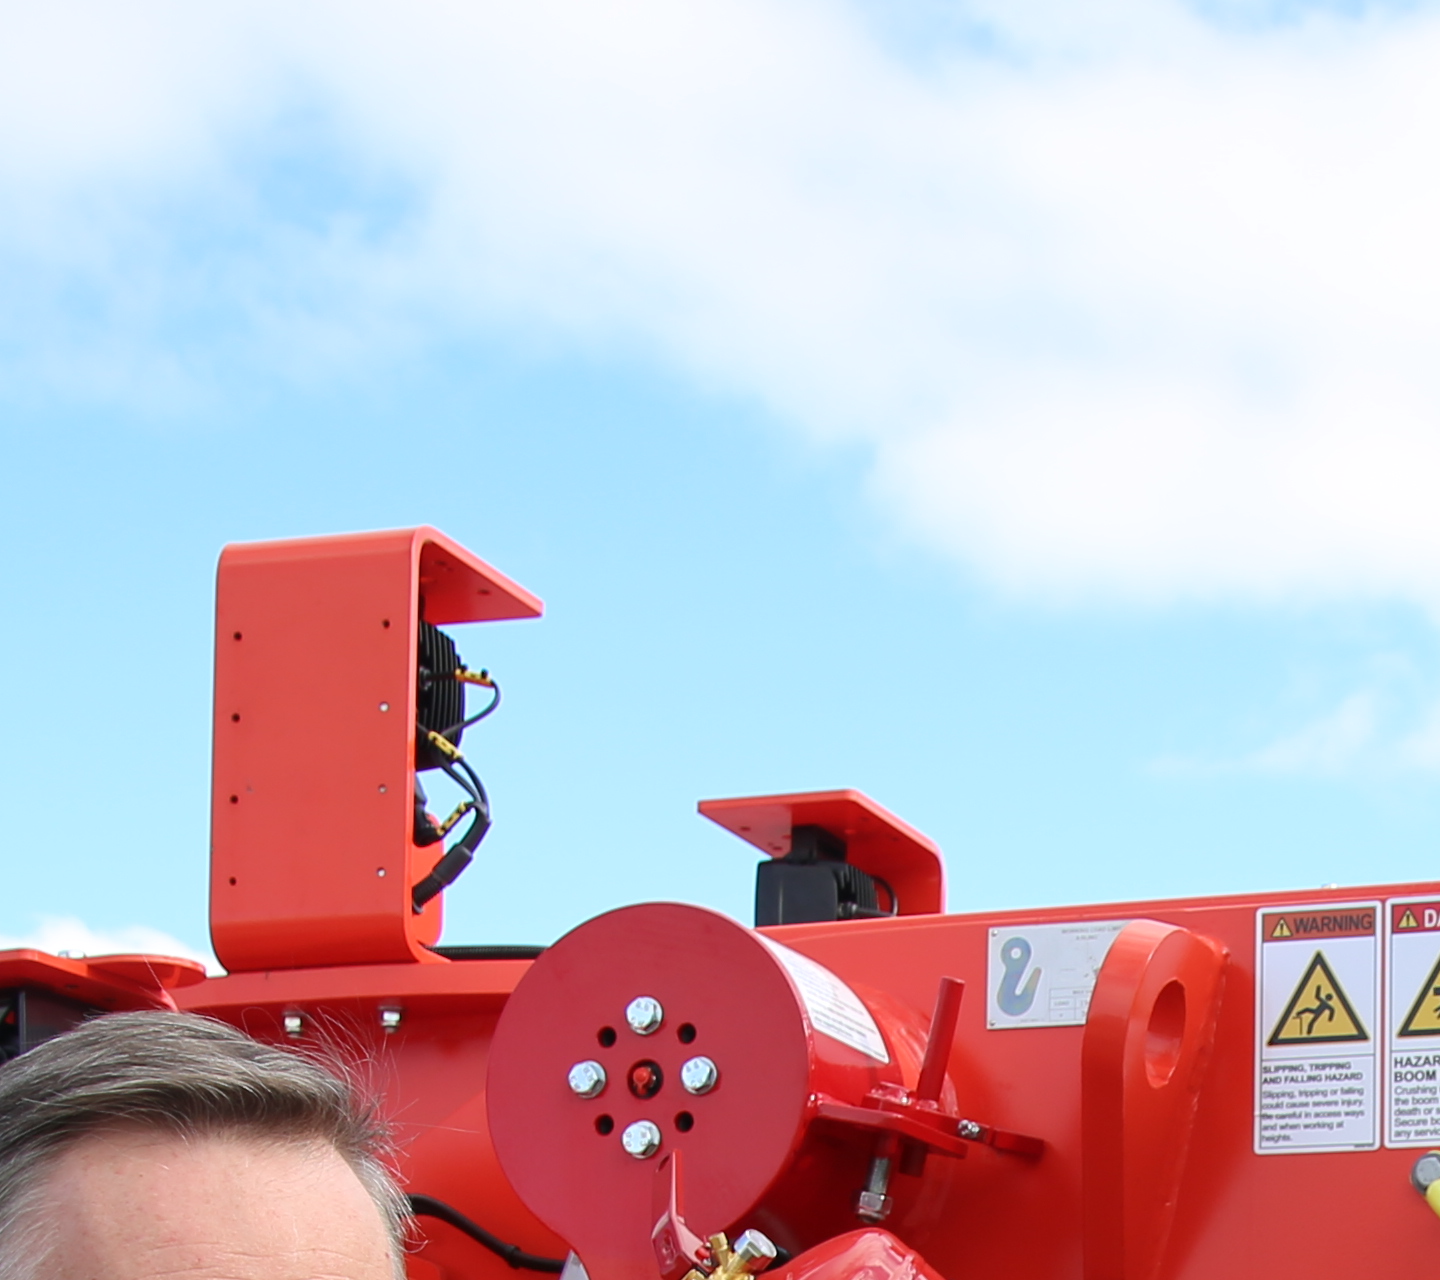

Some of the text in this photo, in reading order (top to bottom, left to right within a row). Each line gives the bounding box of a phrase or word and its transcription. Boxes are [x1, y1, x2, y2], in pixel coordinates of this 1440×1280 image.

[1293, 914, 1372, 933] WARNING
[1263, 1062, 1351, 1074] SLIPPING, TRIPPING
[1263, 1072, 1363, 1085] AND FALLING HAZARD
[1394, 1070, 1437, 1082] BOOM
